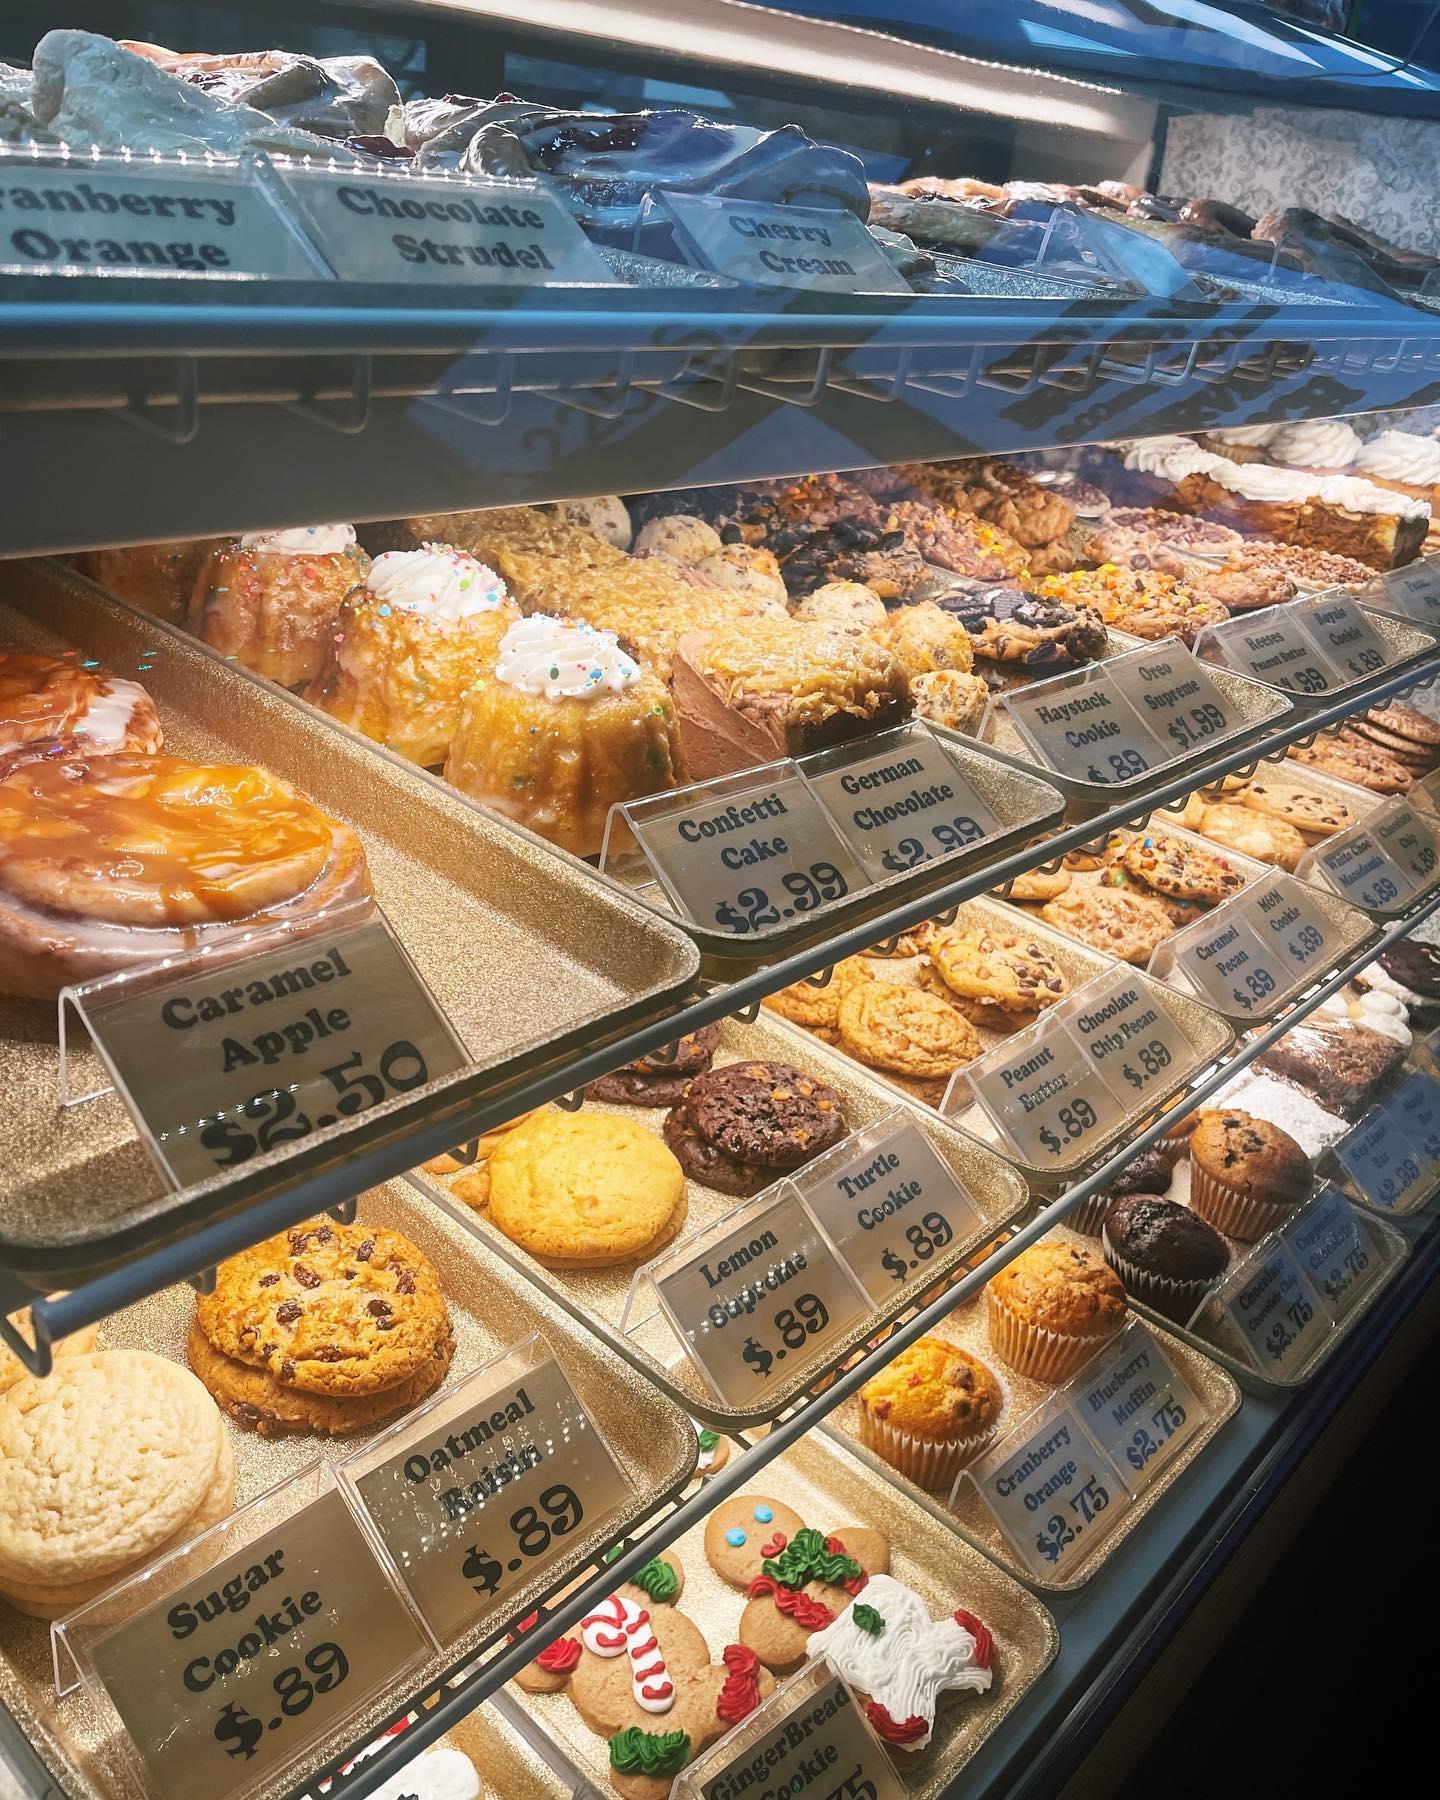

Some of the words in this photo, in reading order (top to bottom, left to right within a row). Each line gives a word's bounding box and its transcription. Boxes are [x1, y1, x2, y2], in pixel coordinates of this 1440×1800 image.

[0, 183, 235, 226] anberry
[336, 187, 545, 229] Chocolate
[10, 229, 230, 271] Orange
[393, 235, 555, 269] Strudel
[729, 216, 832, 247] Cherry
[759, 250, 857, 276] Cream
[1246, 631, 1285, 651] Reeses
[1250, 654, 1282, 673] Peanut
[1279, 647, 1307, 663] Butter
[1329, 627, 1361, 647] Cookie
[1138, 661, 1172, 682] Oreo
[1143, 678, 1200, 711] Supreme
[1034, 691, 1111, 725] Haystack
[1168, 703, 1227, 749] $1.99
[1065, 719, 1121, 749] Cookie
[840, 755, 925, 795] German
[678, 792, 788, 842] Confetti
[853, 782, 954, 831] Chocolate
[720, 834, 788, 870] Cake
[1326, 852, 1352, 872] White
[1351, 840, 1371, 857] Choc
[714, 862, 849, 934] $2.99
[1257, 889, 1284, 913] M&M
[1363, 878, 1398, 908] $.89
[1196, 924, 1240, 960] Caramel
[1270, 906, 1301, 932] Cookie
[1216, 950, 1249, 977] Pecan
[1288, 925, 1324, 964] $.89
[161, 947, 352, 1030] Caramel
[1077, 988, 1139, 1034] Chocolate
[1233, 968, 1276, 1011] $.89
[221, 1007, 352, 1073] Apple
[1090, 1028, 1125, 1060] Chip
[1121, 1009, 1158, 1040] Pecan
[1000, 1046, 1055, 1089] Peanut
[1122, 1039, 1172, 1090] $.89
[200, 1040, 429, 1168] $2.50
[1017, 1073, 1068, 1113] Butter
[1039, 1098, 1098, 1156] $.89
[837, 1150, 901, 1200] Turtle
[857, 1178, 923, 1231] Cookie
[699, 1227, 779, 1288] Lemon
[881, 1211, 954, 1284] $.89
[708, 1250, 808, 1330] Supreme
[742, 1293, 830, 1378] $.89
[1266, 1292, 1313, 1362] $2.75
[1086, 1350, 1151, 1413] Blueberry
[1111, 1381, 1157, 1426] Muffin
[403, 1387, 536, 1485] Oatmeal
[1126, 1393, 1188, 1471] $2.75
[439, 1443, 543, 1521] Raisin
[996, 1425, 1072, 1497] Cranberry
[1023, 1459, 1077, 1512] Orange
[461, 1484, 584, 1597] $.89
[1036, 1474, 1110, 1564] $2.75
[167, 1550, 285, 1639] Sugar
[182, 1590, 323, 1693] Cookie
[214, 1641, 350, 1762] $.89
[709, 1682, 850, 1800] GingerBread
